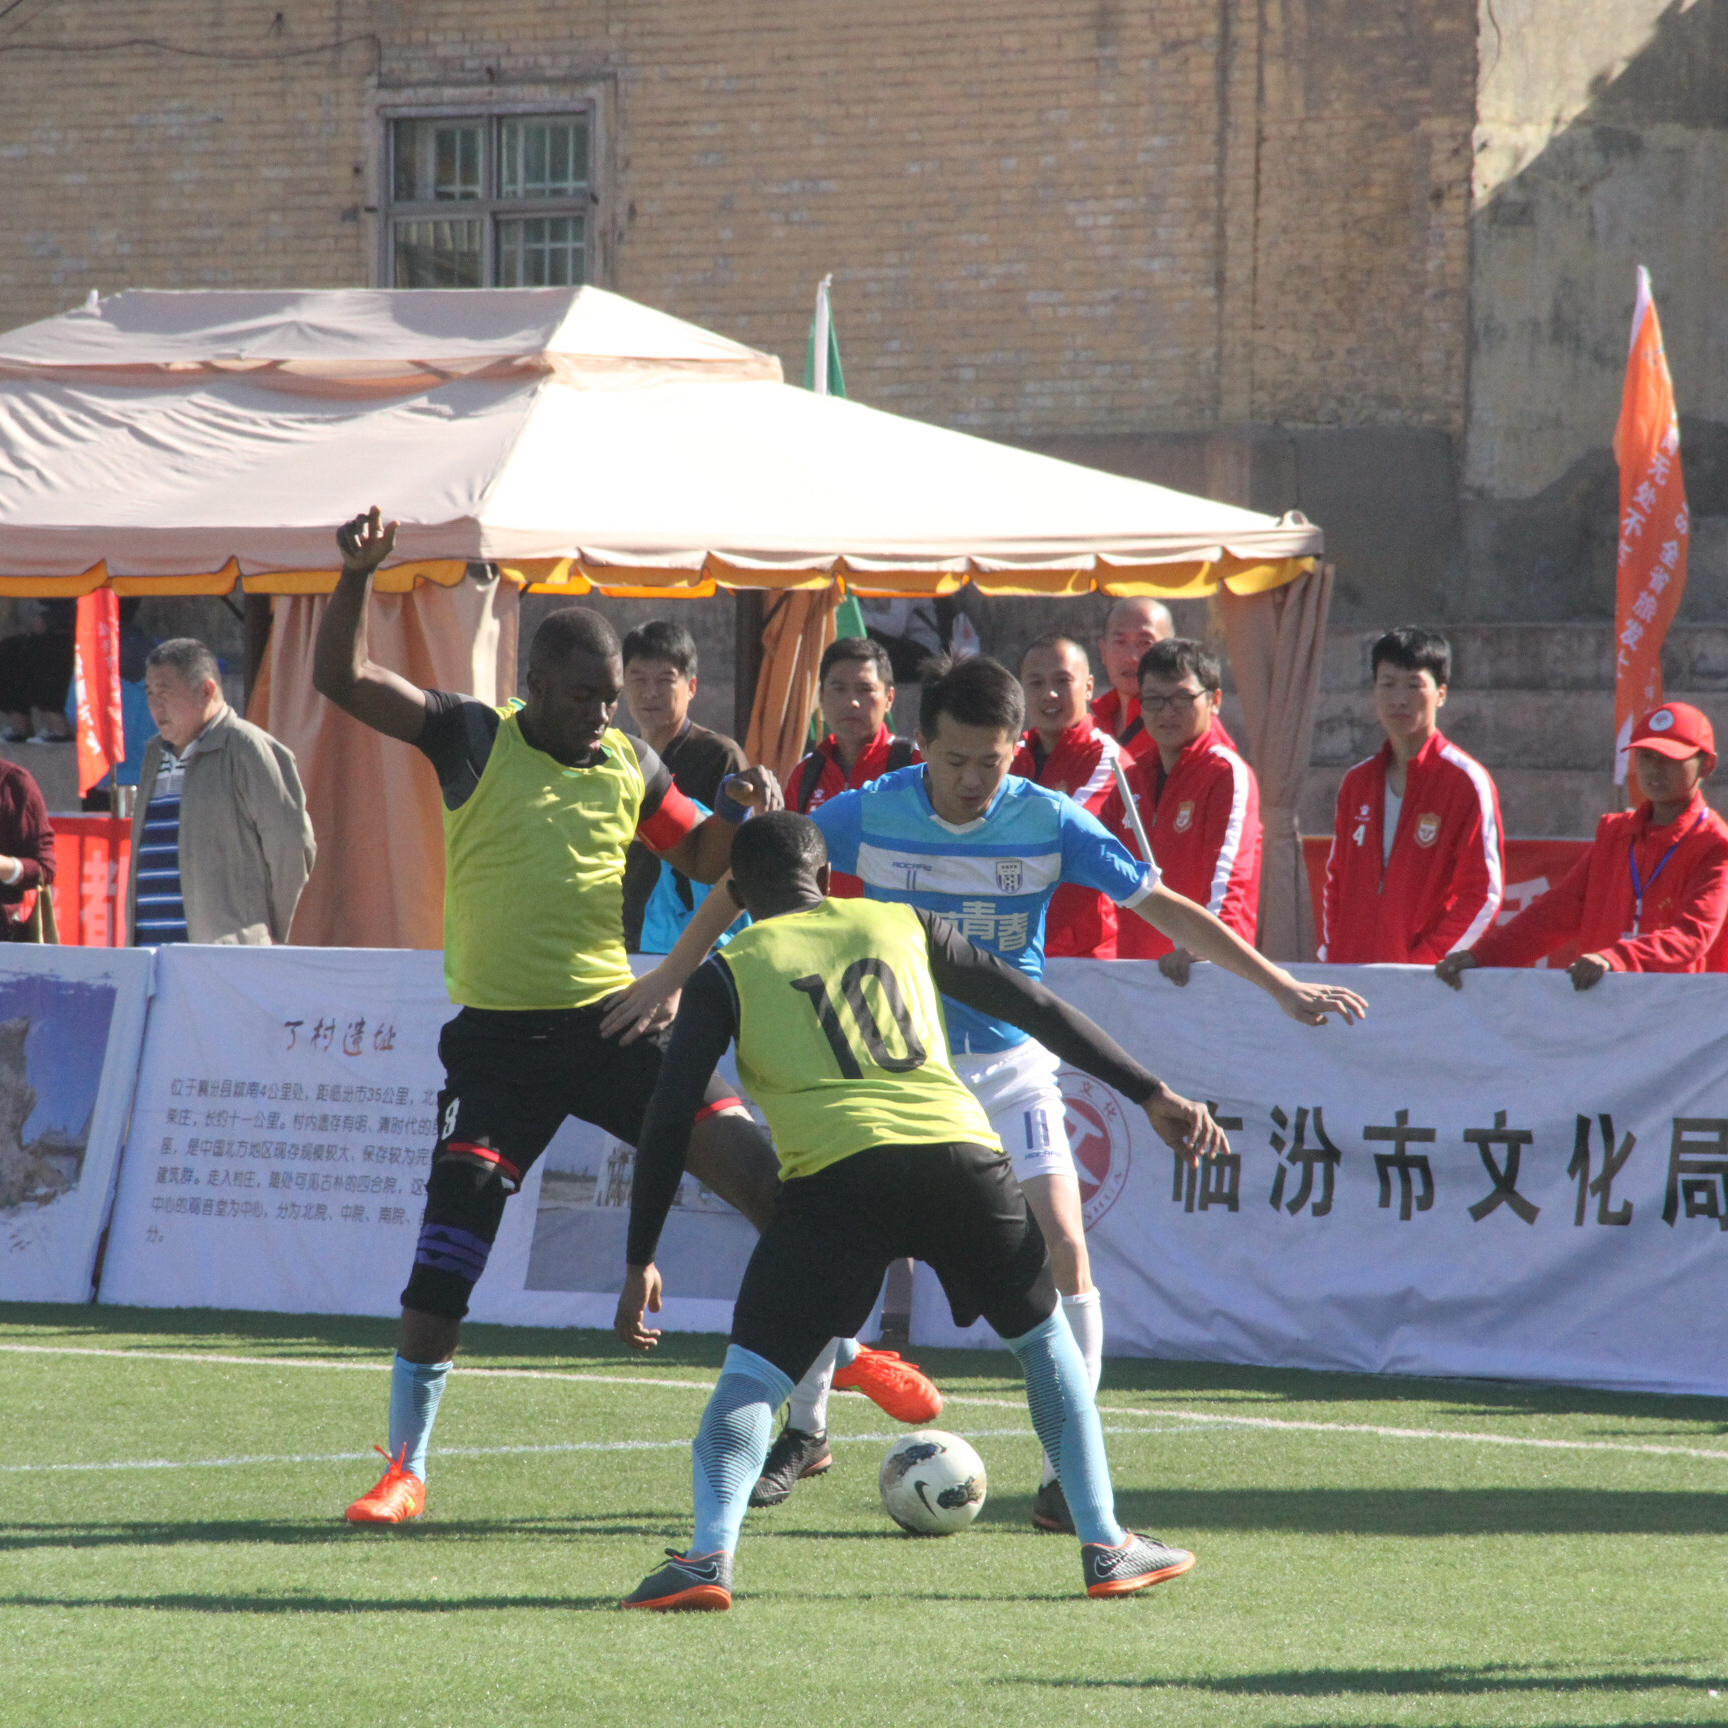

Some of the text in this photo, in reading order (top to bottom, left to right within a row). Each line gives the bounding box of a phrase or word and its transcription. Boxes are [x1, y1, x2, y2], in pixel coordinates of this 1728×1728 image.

[1352, 824, 1366, 847] 4
[789, 957, 927, 1080] 10
[441, 1096, 460, 1141] 8
[1171, 1100, 1728, 1231] 临汾市文化局
